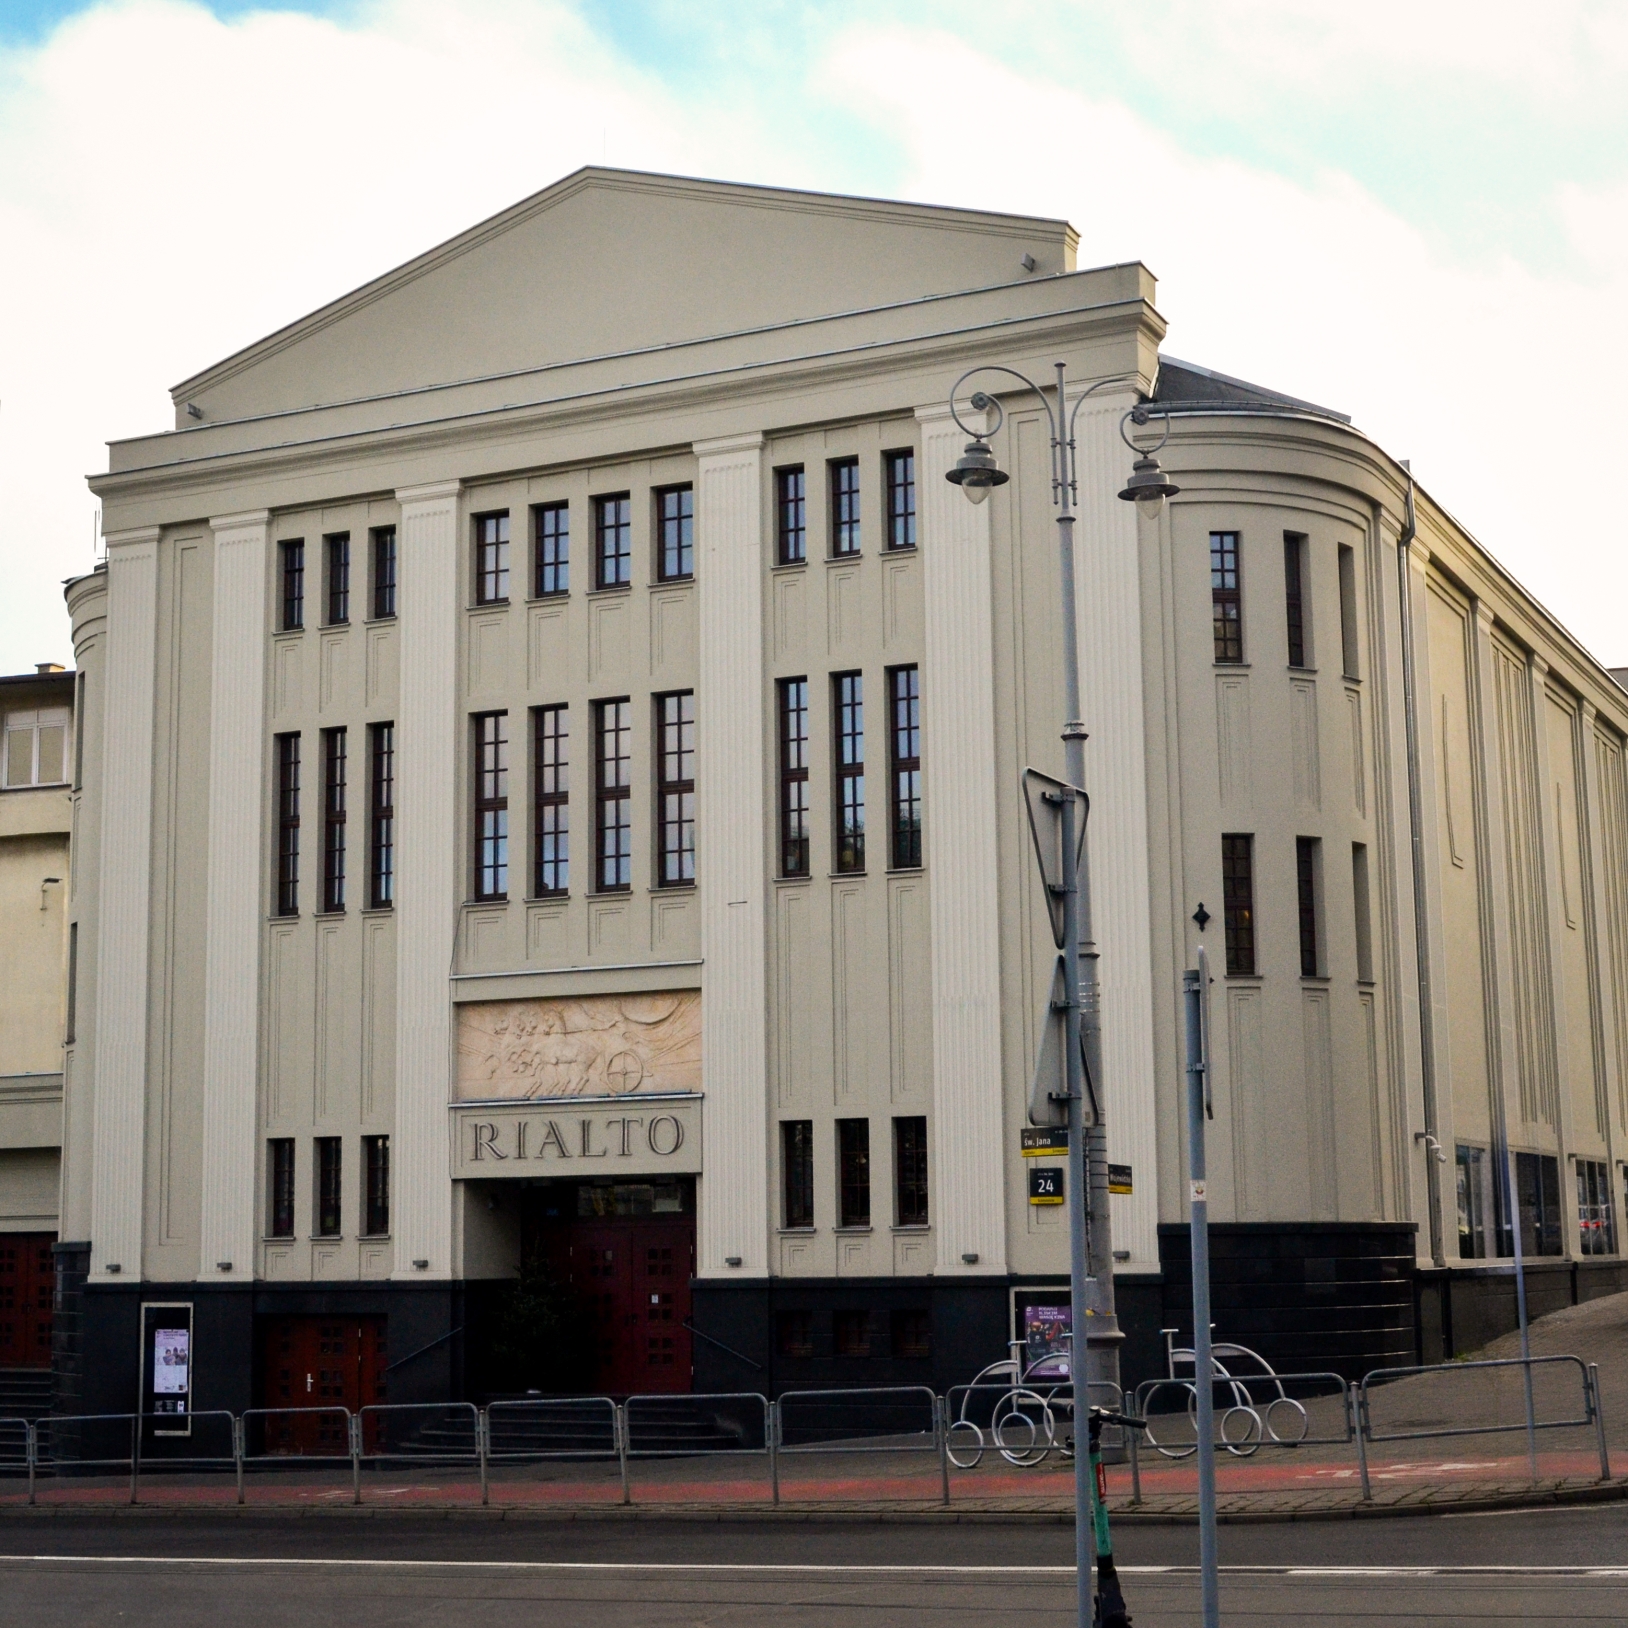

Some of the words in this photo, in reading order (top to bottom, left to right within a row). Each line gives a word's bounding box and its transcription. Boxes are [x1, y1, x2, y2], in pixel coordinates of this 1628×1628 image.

[469, 1114, 685, 1161] RIALTO
[1036, 1137, 1051, 1147] Jana
[1037, 1179, 1054, 1193] 24
